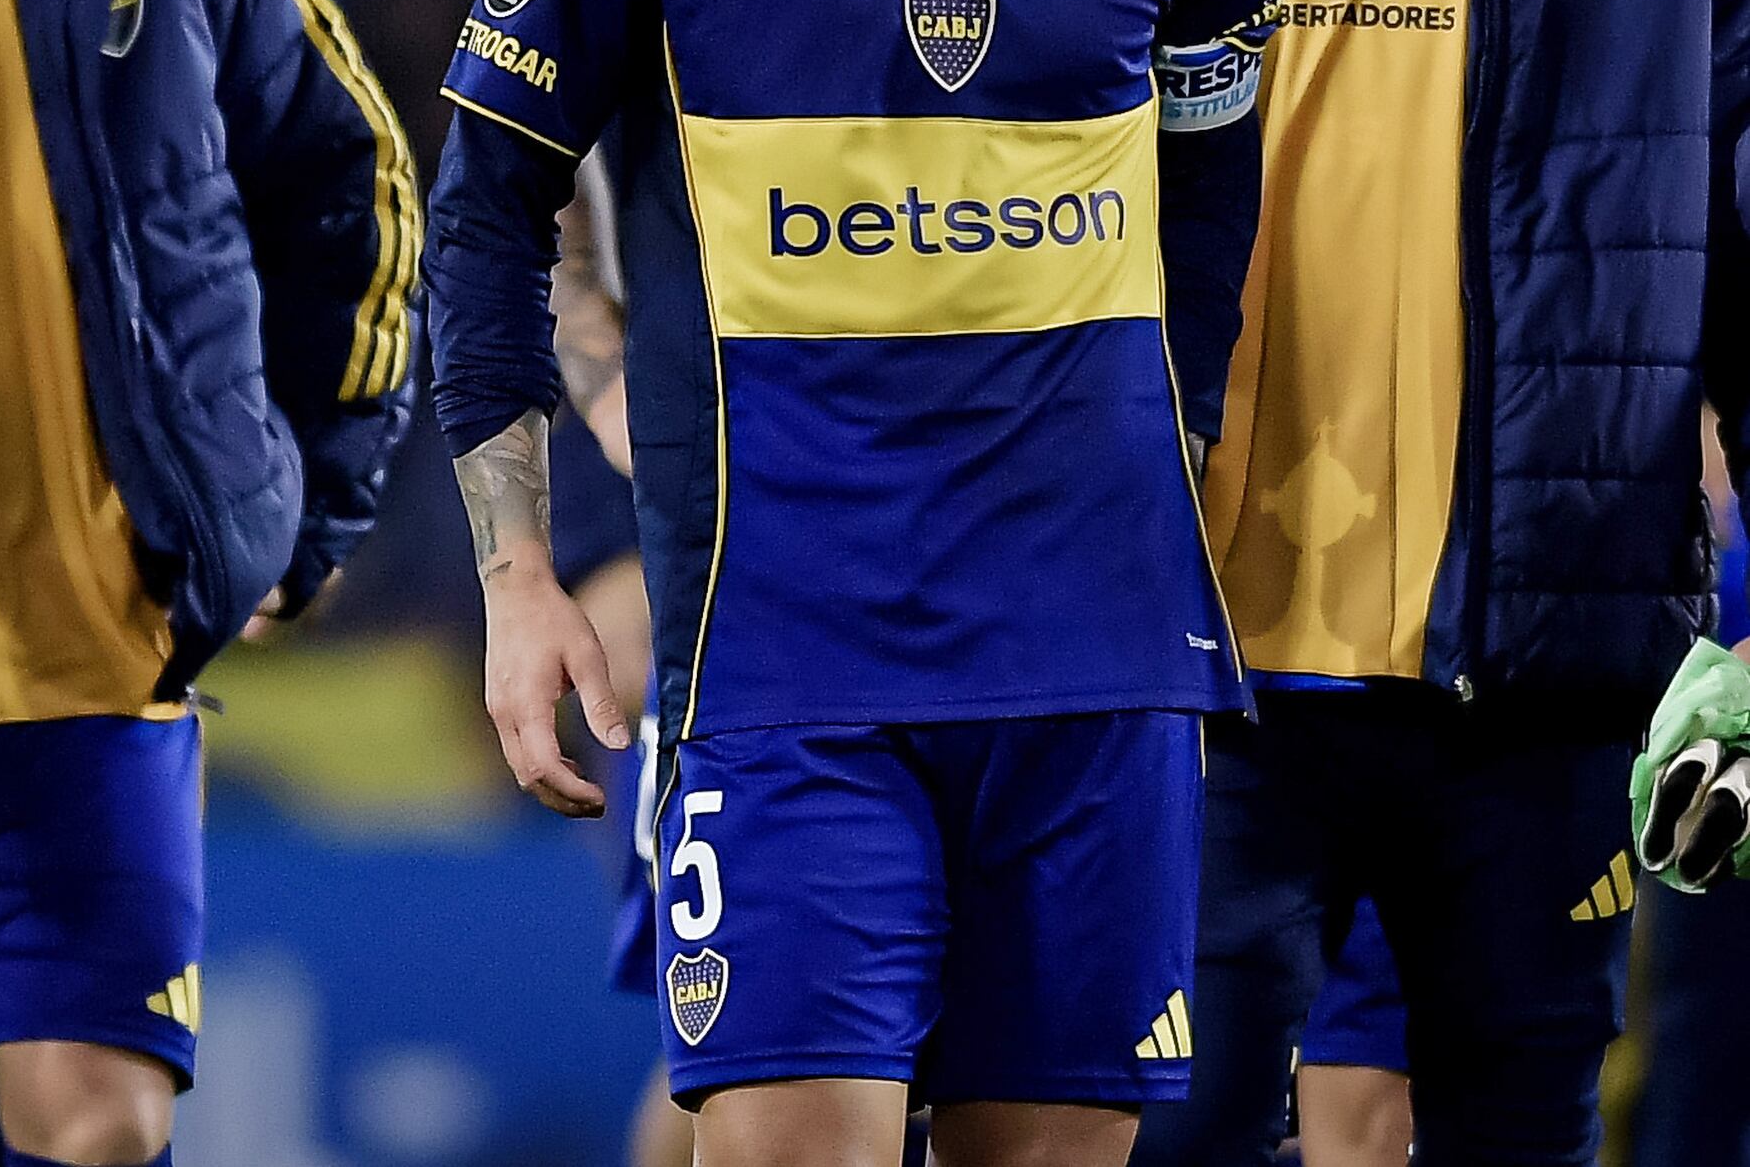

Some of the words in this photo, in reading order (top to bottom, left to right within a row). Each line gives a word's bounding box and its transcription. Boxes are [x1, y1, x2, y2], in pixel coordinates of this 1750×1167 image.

[917, 14, 982, 40] CABJ
[1157, 51, 1262, 99] RESP
[768, 185, 1125, 257] betsson
[670, 790, 724, 941] 5
[676, 979, 718, 1005] CABJ
